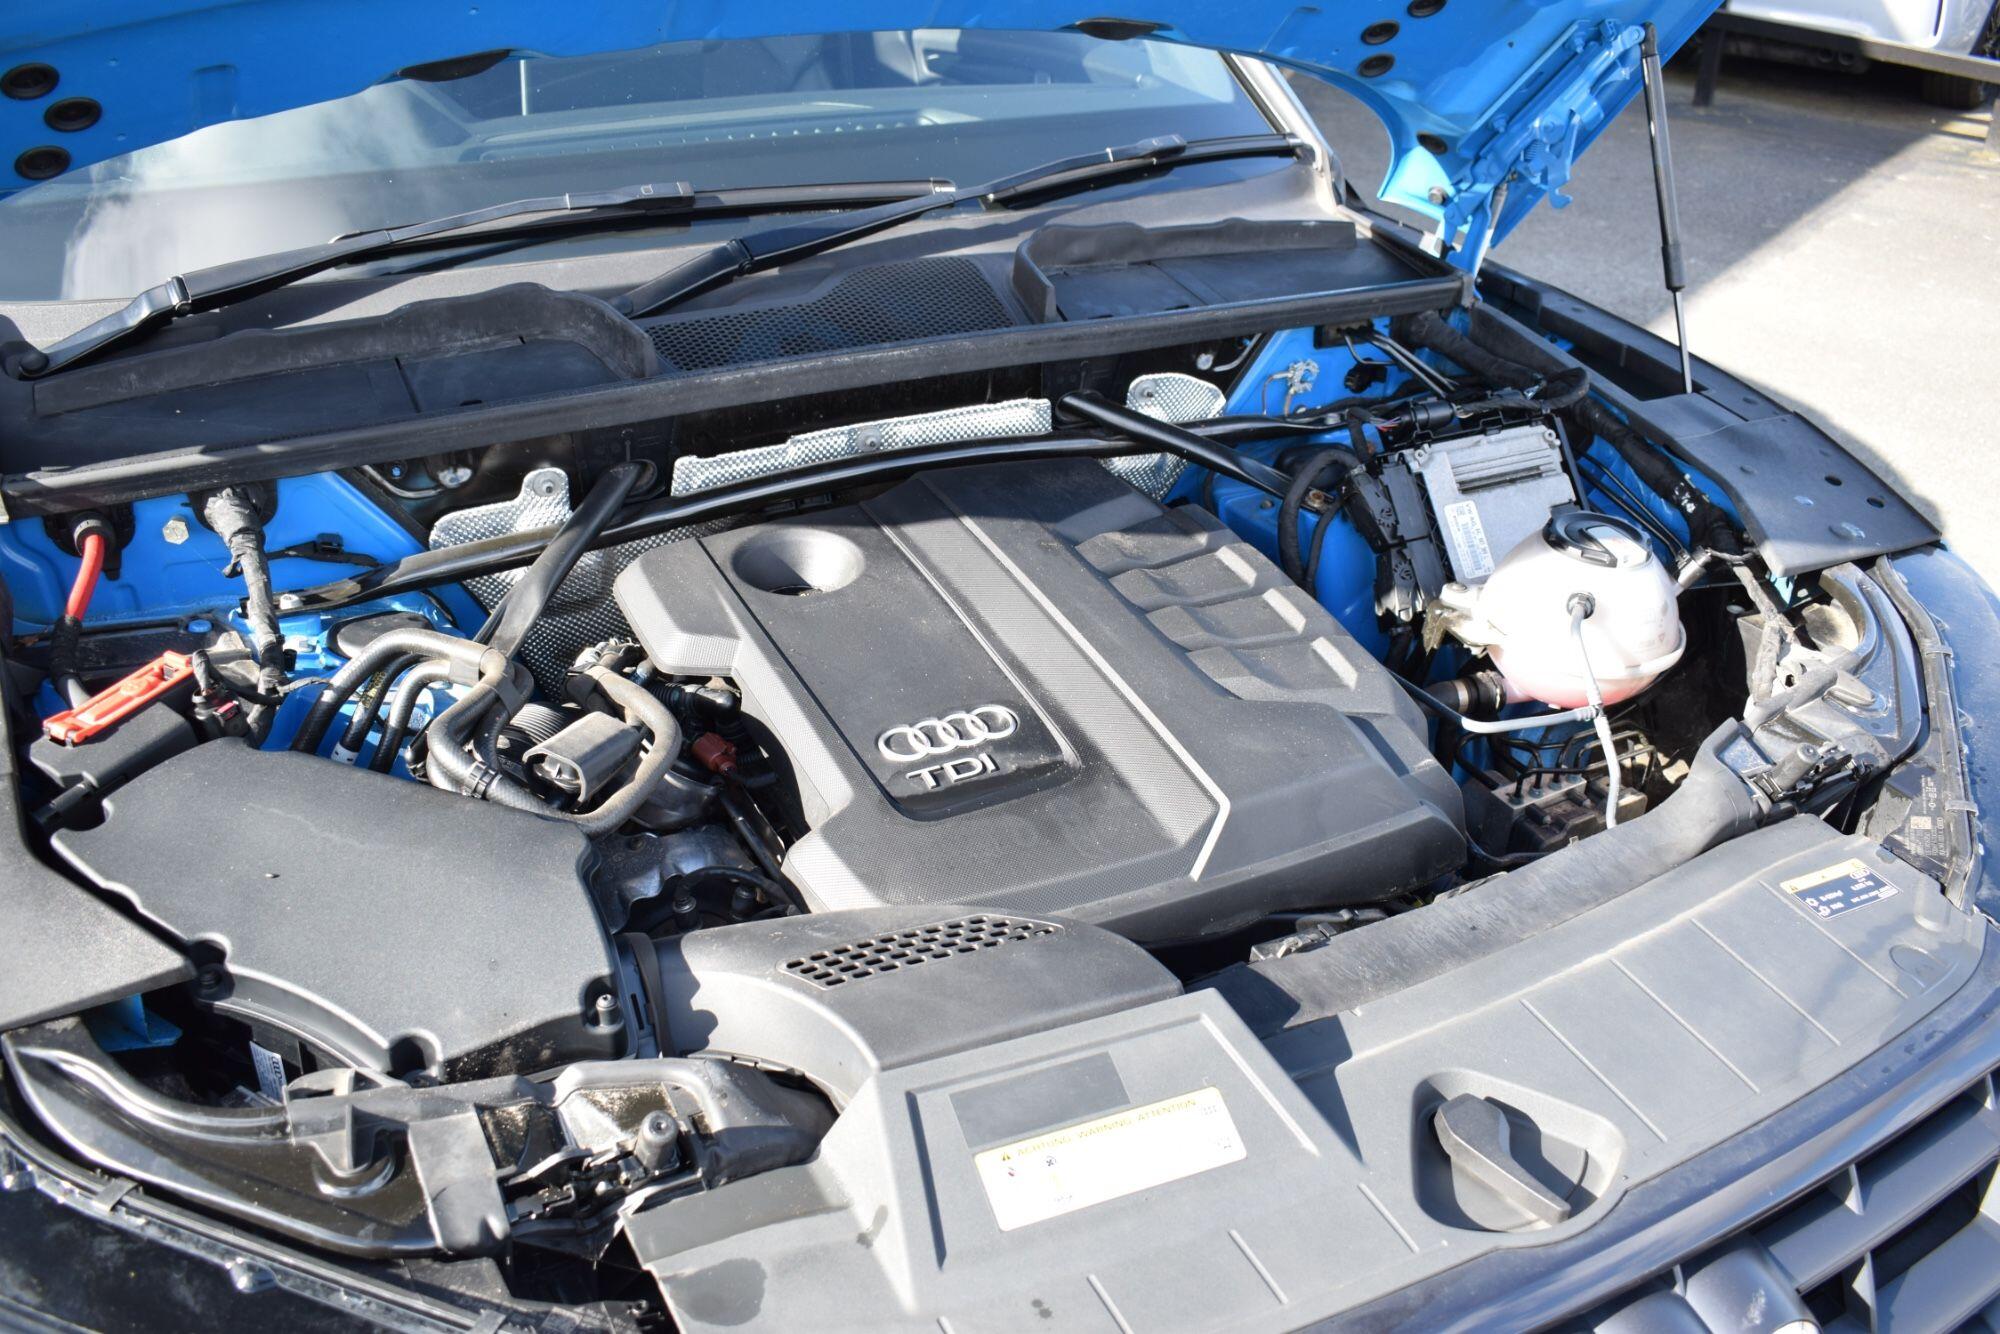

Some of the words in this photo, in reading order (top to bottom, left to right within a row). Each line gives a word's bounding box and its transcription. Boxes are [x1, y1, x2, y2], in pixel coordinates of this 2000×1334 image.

[906, 752, 999, 789] TDI
[1018, 1136, 1072, 1156] ACHTUNG
[1078, 1118, 1132, 1139] WARNING
[1137, 1099, 1196, 1121] ATTENTION
